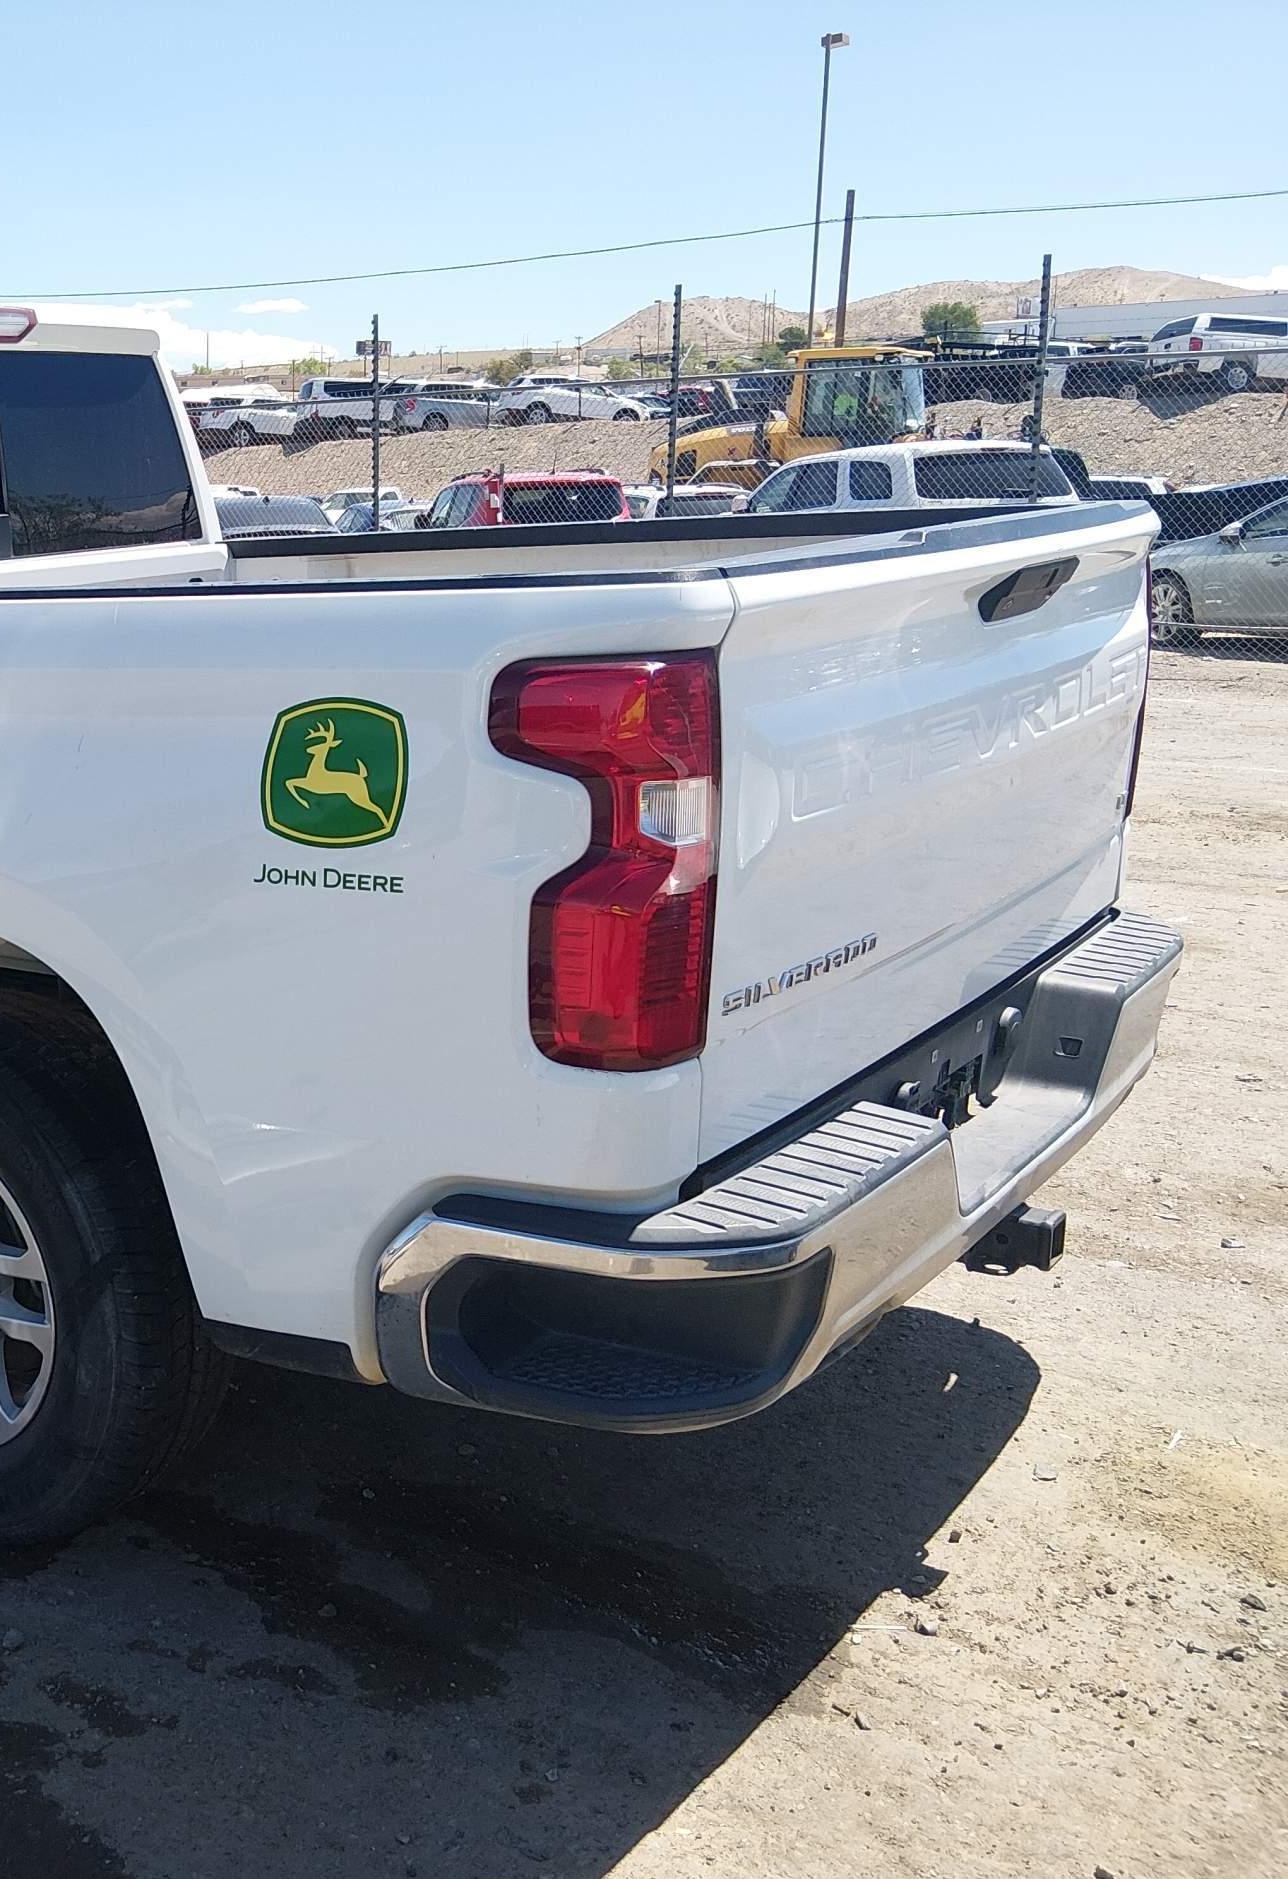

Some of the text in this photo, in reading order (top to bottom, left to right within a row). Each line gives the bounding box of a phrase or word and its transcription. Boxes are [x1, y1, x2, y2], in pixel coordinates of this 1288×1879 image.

[253, 864, 404, 893] JOHN DEERE
[721, 932, 878, 1016] SILVERADO
